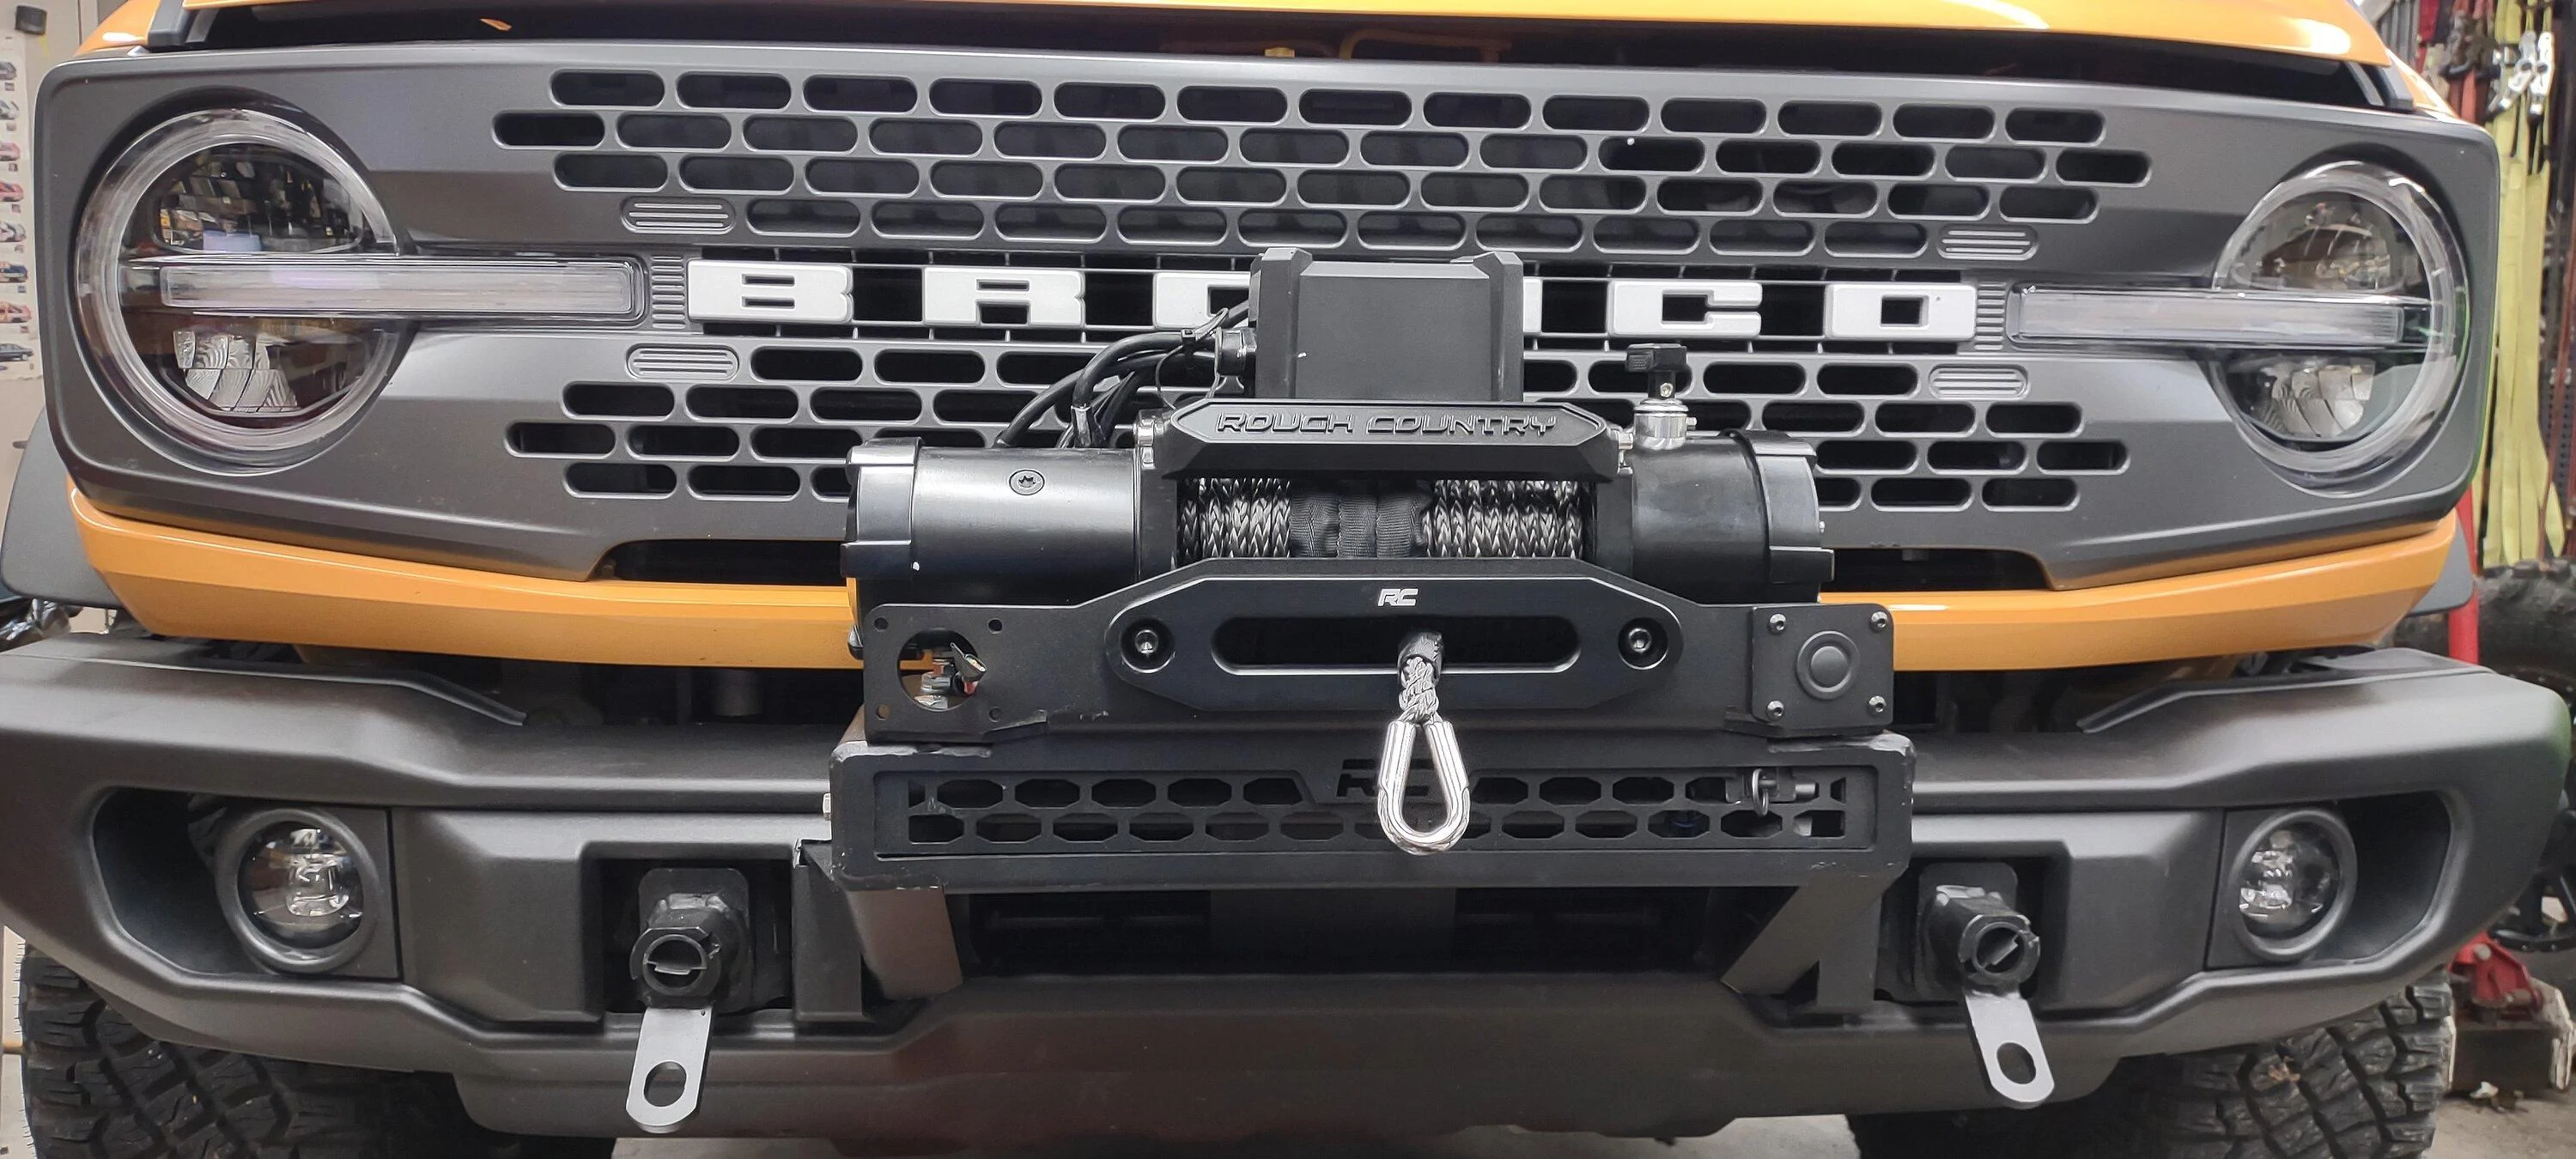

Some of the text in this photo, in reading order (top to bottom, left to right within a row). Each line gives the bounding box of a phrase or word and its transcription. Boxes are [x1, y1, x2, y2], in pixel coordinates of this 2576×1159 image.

[687, 258, 1977, 340] BROCO
[1217, 411, 1556, 437] ROUGH COUNTRY
[1377, 588, 1419, 607] RC
